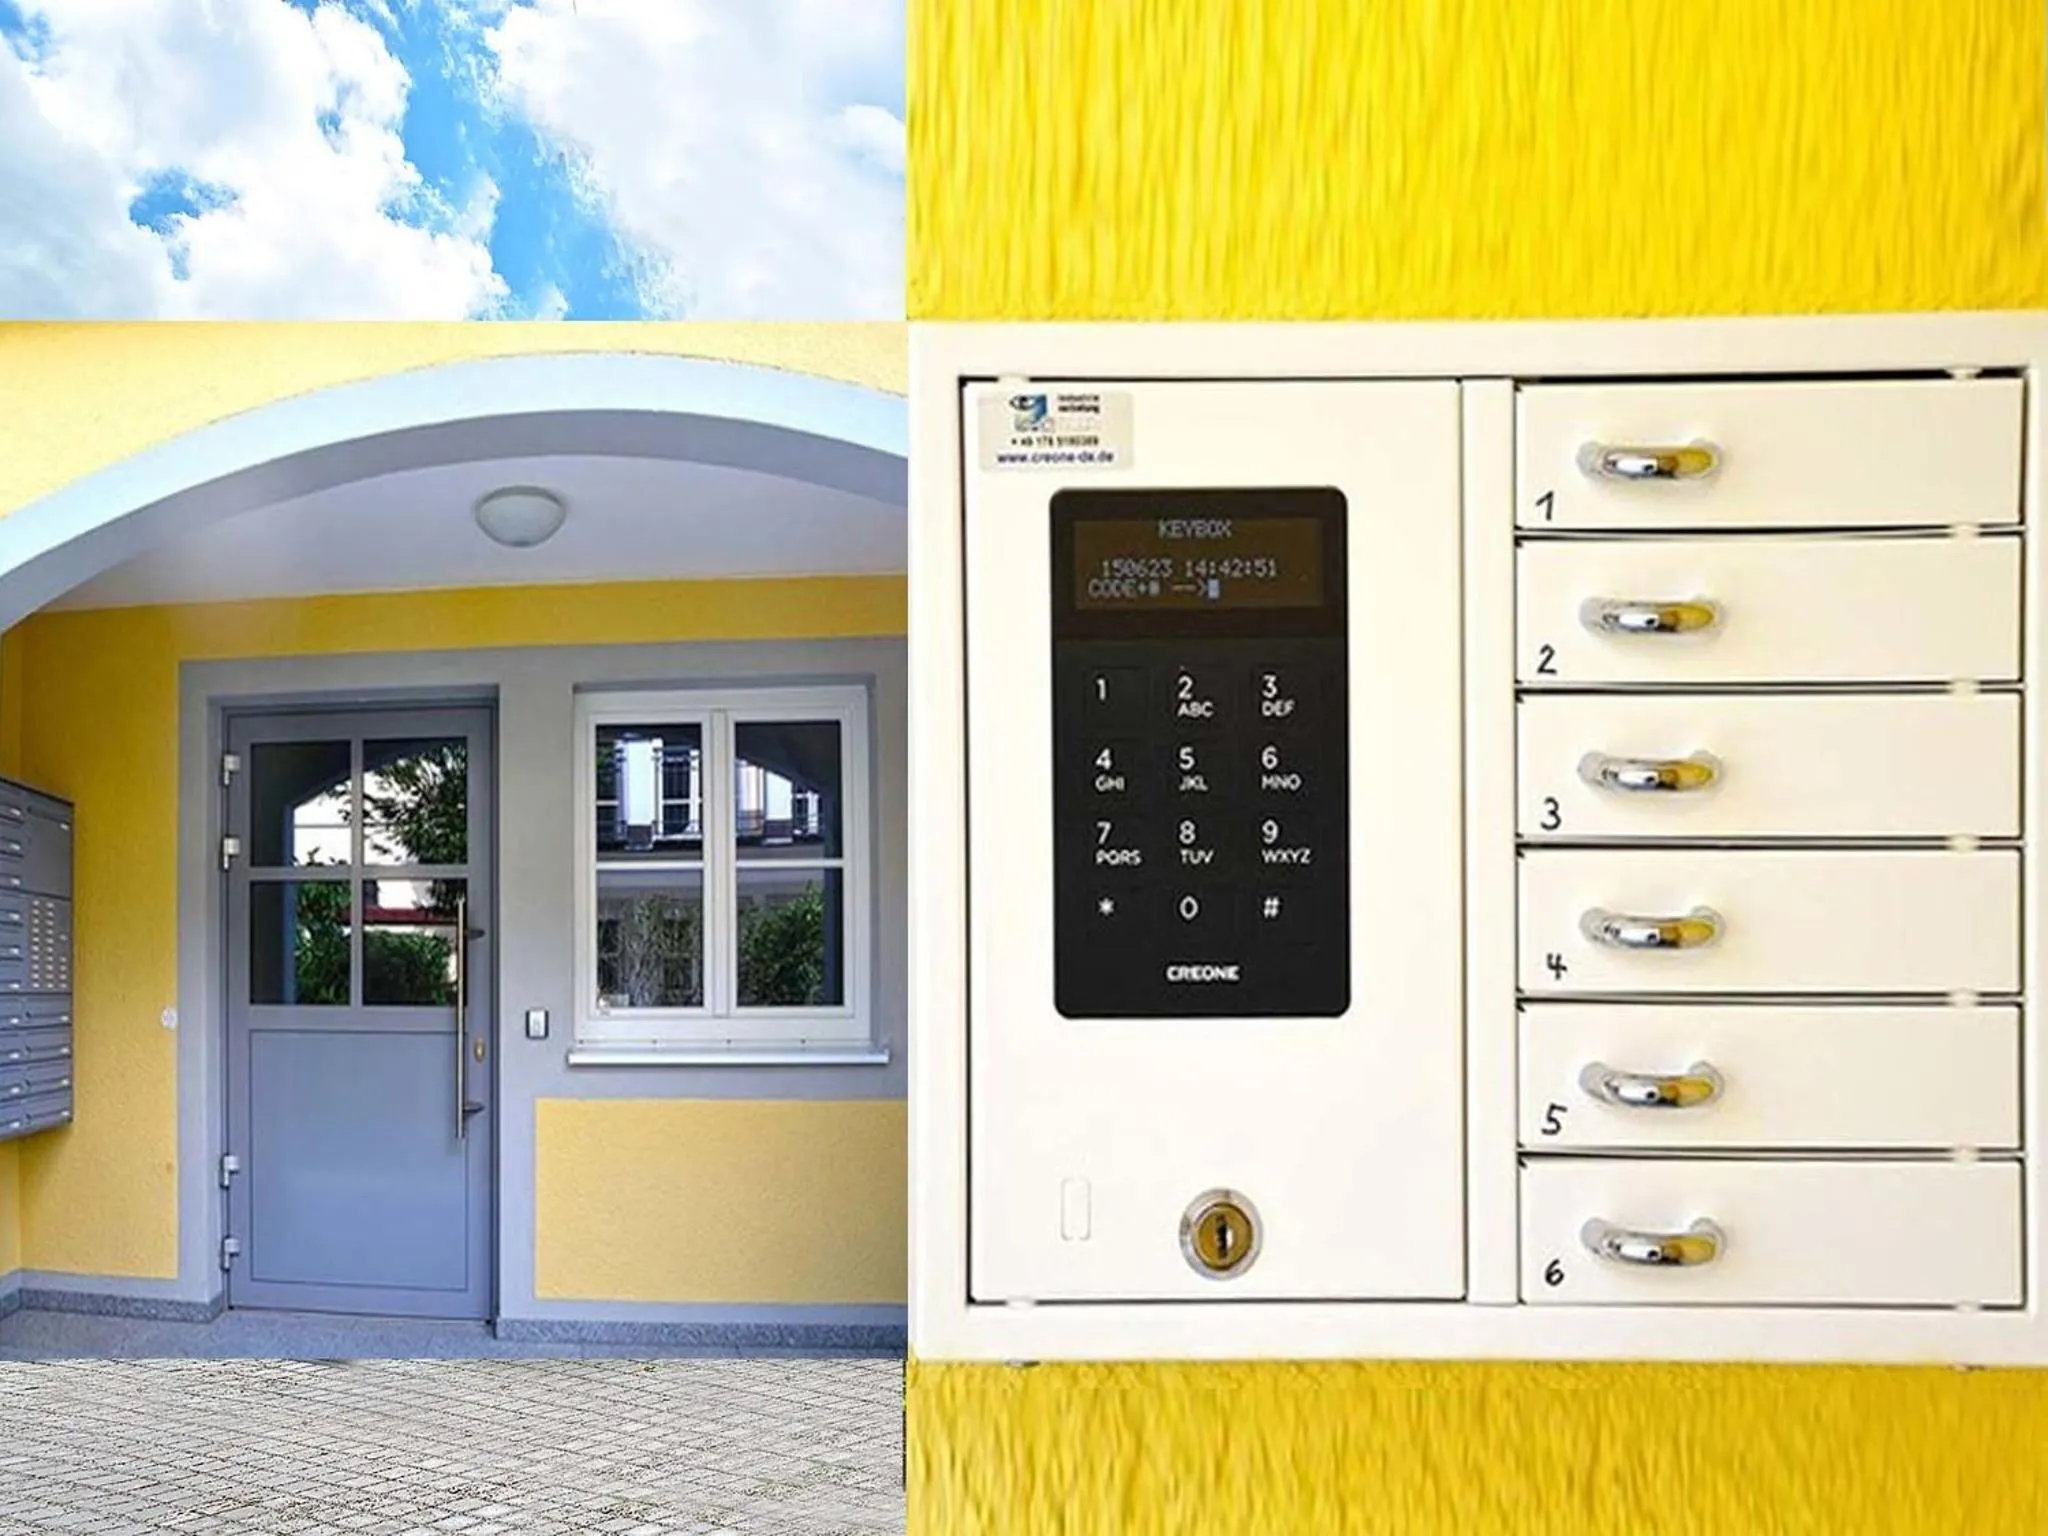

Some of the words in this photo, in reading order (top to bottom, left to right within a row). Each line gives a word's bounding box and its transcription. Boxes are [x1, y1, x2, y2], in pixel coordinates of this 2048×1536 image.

[1536, 490, 1556, 521] 1
[1158, 520, 1232, 538] KEYBOX
[1101, 559, 1173, 579] 150623
[1185, 559, 1277, 579] 14:42:51
[1536, 643, 1558, 675] 2
[1096, 678, 1106, 700] 1
[1179, 676, 1193, 700] 2
[1262, 675, 1278, 698] 3
[1178, 702, 1213, 717] ABC
[1262, 701, 1295, 717] DEF
[1096, 748, 1111, 770] 4
[1179, 747, 1195, 770] 5
[1262, 746, 1278, 769] 6
[1095, 775, 1125, 791] GHI
[1179, 775, 1208, 791] JKL
[1262, 774, 1301, 791] MNO
[1540, 796, 1562, 831] 3
[1096, 822, 1111, 844] 7
[1180, 820, 1196, 844] 8
[1262, 819, 1278, 844] 9
[1180, 850, 1213, 865] TUV
[1262, 849, 1311, 865] WXYZ
[1166, 965, 1239, 982] CREONE
[1545, 952, 1568, 982] 4
[1542, 1103, 1567, 1136] 5
[1545, 1259, 1565, 1288] 6
